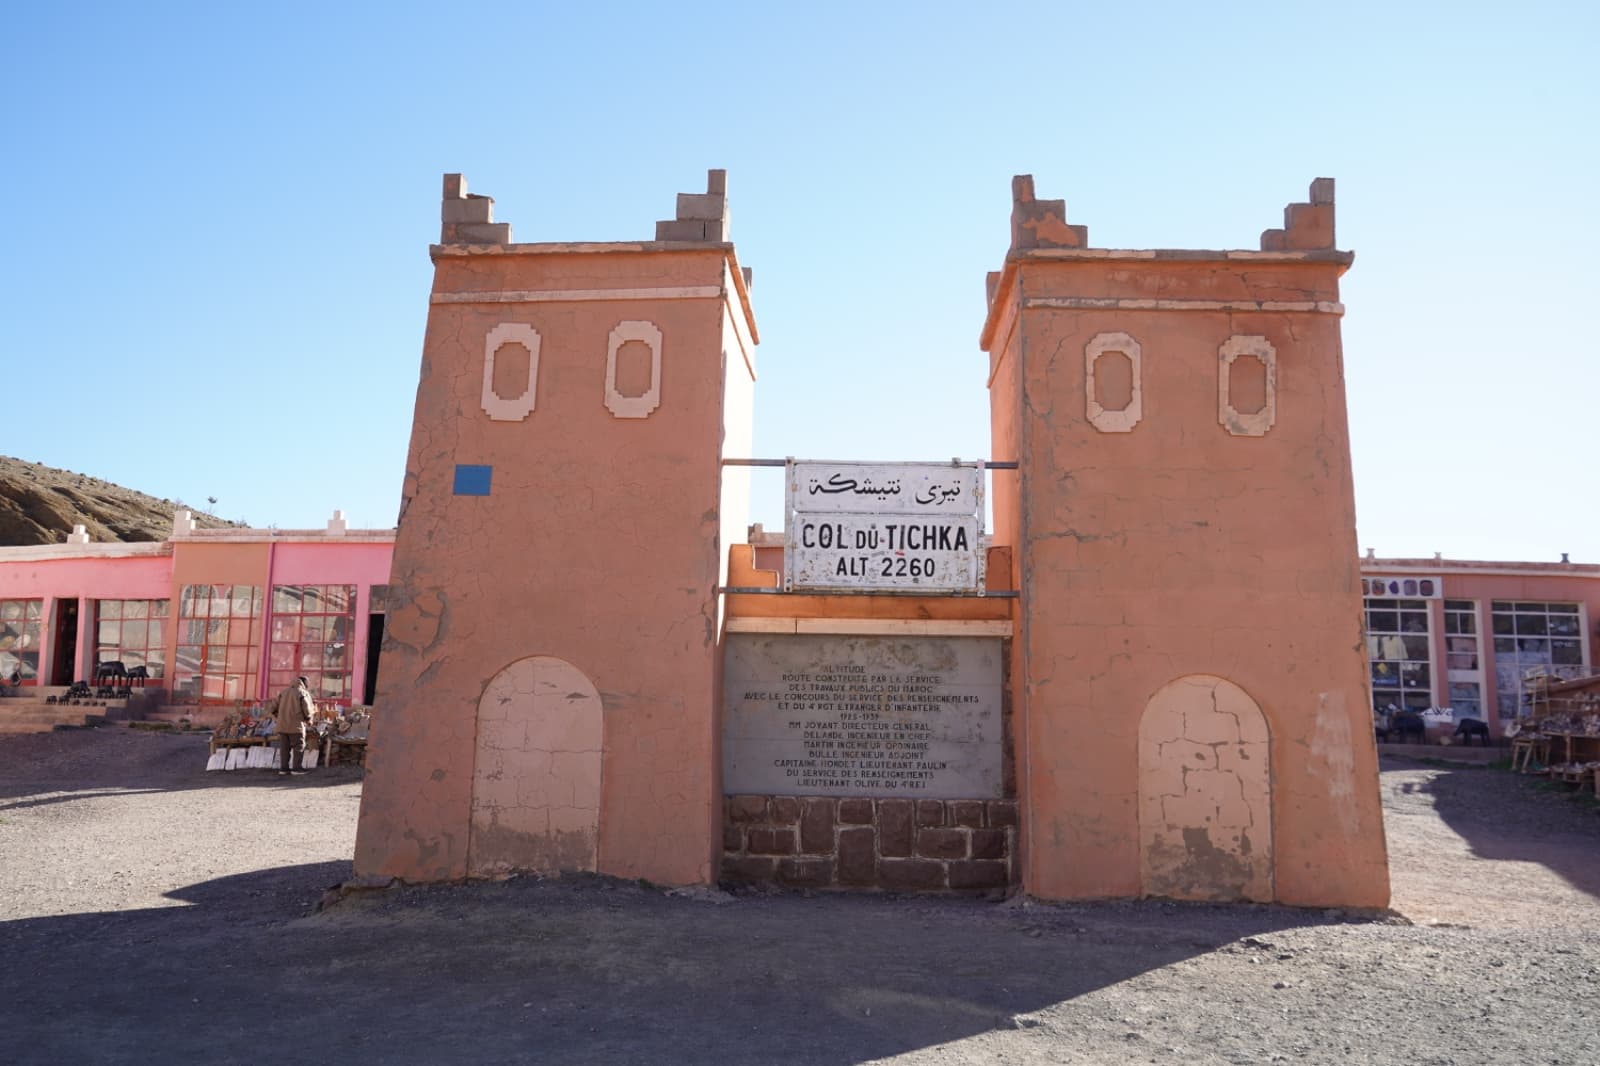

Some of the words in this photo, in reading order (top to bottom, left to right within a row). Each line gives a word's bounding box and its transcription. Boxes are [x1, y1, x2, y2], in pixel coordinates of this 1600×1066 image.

[802, 523, 848, 549] COL
[856, 530, 878, 549] DU
[885, 525, 968, 551] TICHKA
[836, 557, 869, 576] ALT
[881, 558, 935, 577] 2260
[782, 674, 811, 682] ROUTE
[815, 674, 867, 682] CONSTRUITE
[871, 675, 887, 683] PAR
[905, 675, 941, 684] SERVICE
[810, 684, 846, 692] TRAVAUX
[849, 684, 884, 693] PUBLICS
[888, 685, 900, 693] DU
[903, 685, 934, 693] MAROC
[744, 692, 766, 700] AVEC
[769, 692, 780, 700] LE
[784, 693, 830, 701] CONCOURS
[833, 693, 844, 701] DU
[849, 694, 883, 702] SERVICE
[887, 694, 904, 702] DES
[907, 695, 979, 704] RENSEIGNEMENTS
[778, 702, 789, 710] ET
[793, 702, 805, 711] DU
[817, 703, 834, 711] RGT
[838, 703, 882, 712] ETRANGER
[789, 721, 801, 729] MM
[804, 721, 839, 729] JOYANT
[842, 722, 890, 730] DIRECTEUR
[892, 722, 931, 731] GENERAL
[847, 731, 891, 740] INGENIEUR
[894, 732, 905, 740] EN
[908, 732, 929, 741] CHEF
[803, 741, 833, 749] MARTIN
[837, 741, 881, 749] INGENIEUR
[885, 742, 929, 750] ORDINAIRE
[809, 750, 839, 759] BULLE
[842, 751, 885, 759] INGENIEUR
[888, 751, 924, 760] ADJOINT
[774, 759, 815, 768] CAPITAINE
[860, 760, 912, 769] LIEUTENANT
[916, 761, 947, 770] PAULIN
[786, 769, 799, 777] DU
[802, 769, 838, 777] SERVICE
[841, 770, 858, 778] DES
[861, 770, 934, 779] RENSEIGNEMENTS
[797, 779, 850, 787] LIEUTENANT
[885, 780, 897, 789] DU
